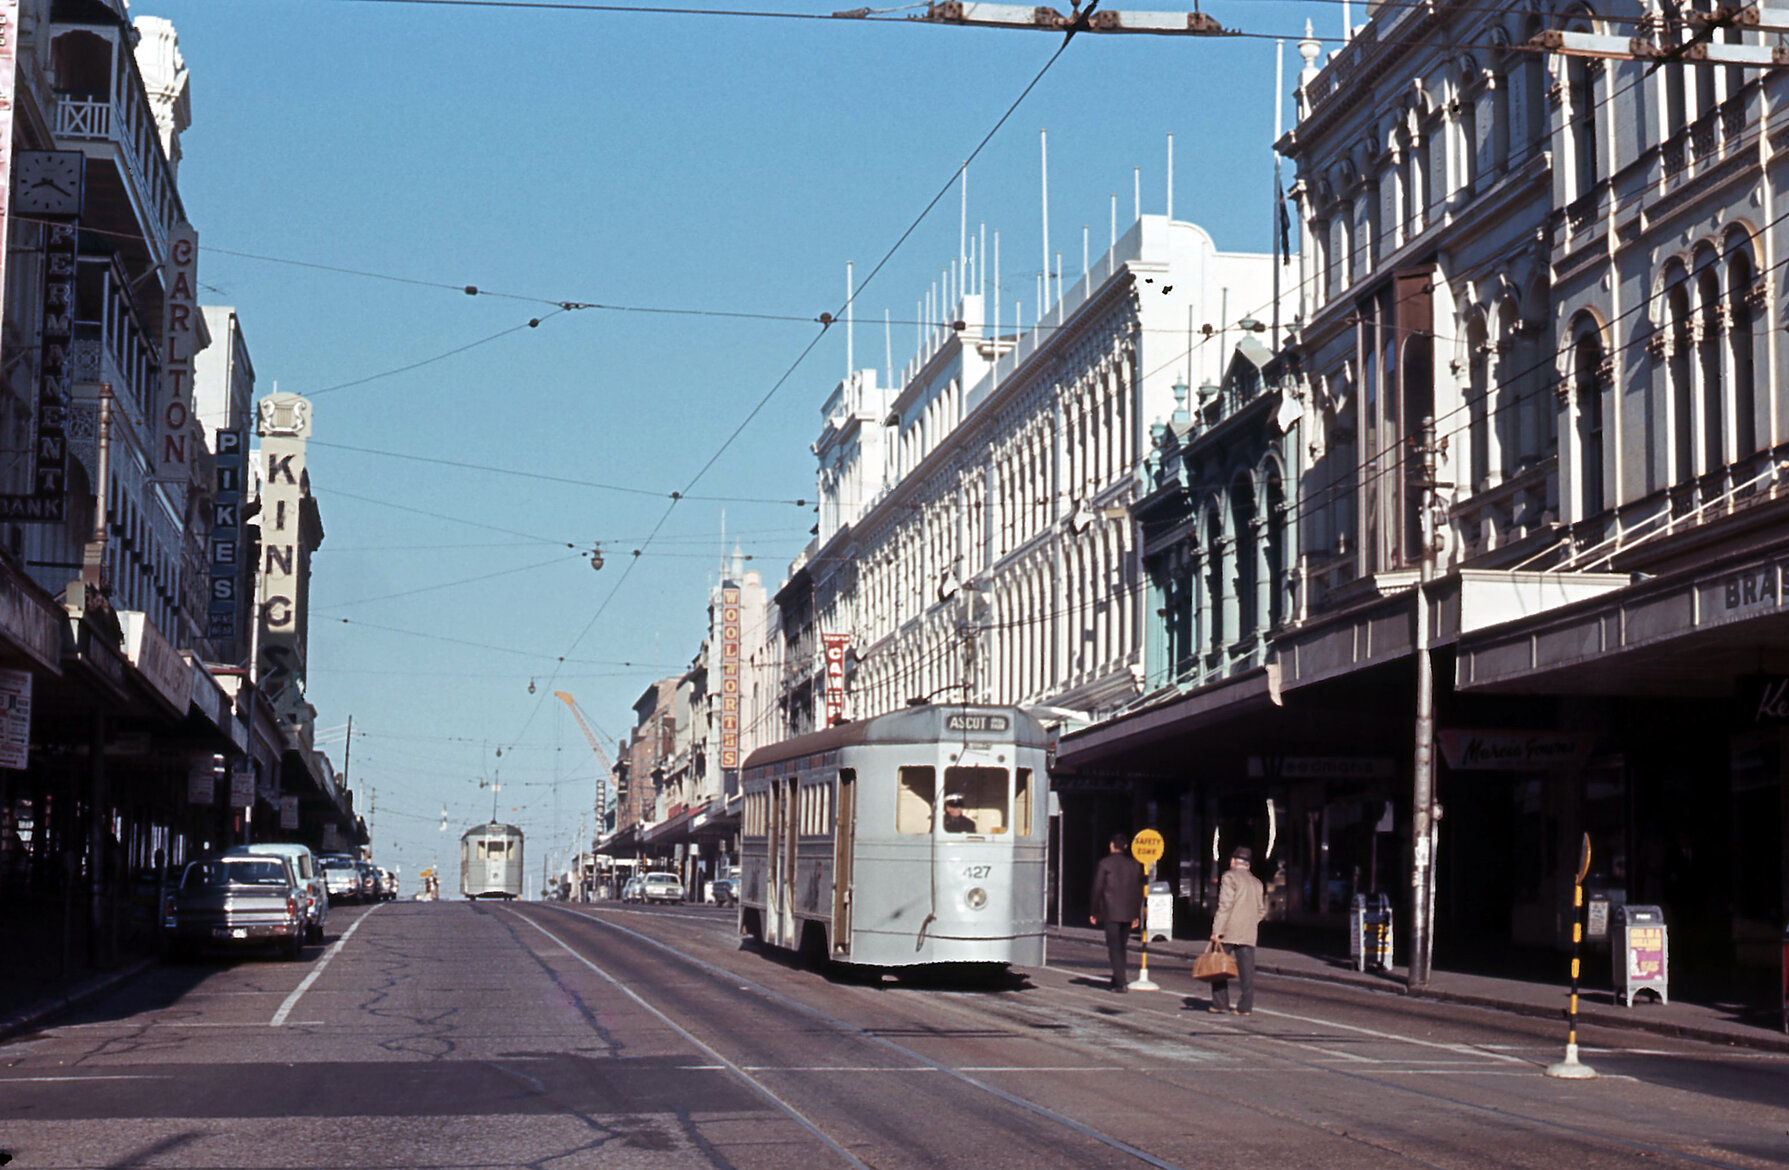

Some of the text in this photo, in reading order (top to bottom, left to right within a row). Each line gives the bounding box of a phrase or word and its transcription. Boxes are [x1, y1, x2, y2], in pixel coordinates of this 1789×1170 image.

[39, 223, 73, 492] PERMANENT
[164, 239, 193, 464] CARLTON
[214, 434, 238, 600] PIKES
[723, 588, 740, 767] WOOLWORTHS
[963, 865, 993, 880] 427
[1134, 837, 1161, 845] SAFETY
